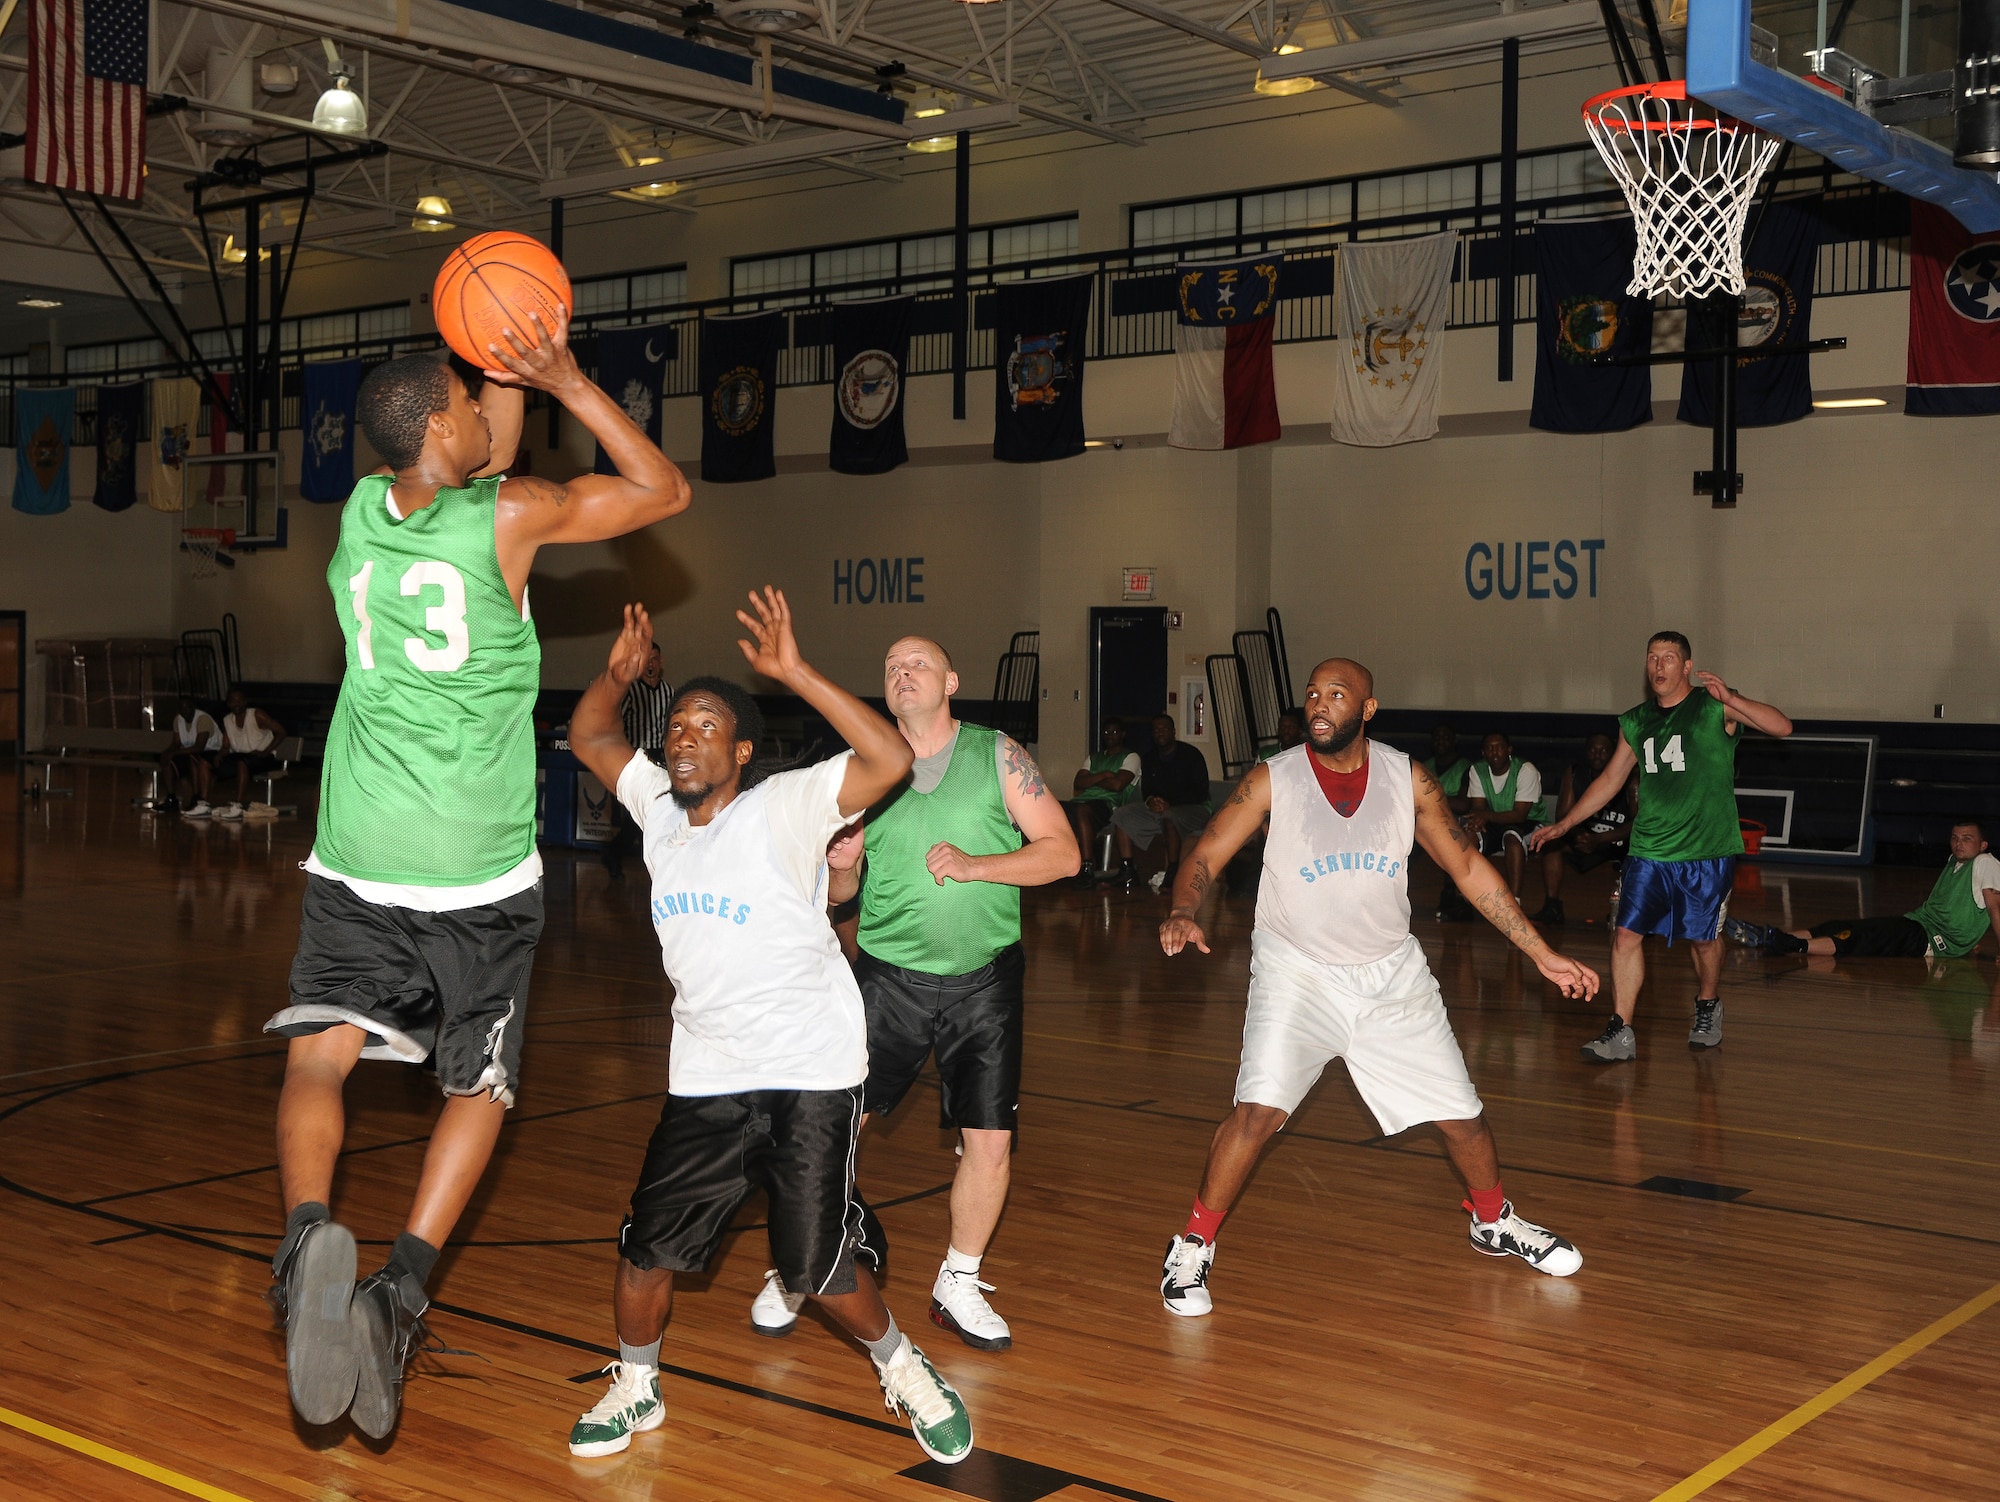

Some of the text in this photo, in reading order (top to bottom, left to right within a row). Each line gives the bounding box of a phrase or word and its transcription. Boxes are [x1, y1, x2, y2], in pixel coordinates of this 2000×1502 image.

[834, 557, 924, 604] HOME
[1130, 574, 1149, 591] EXIT
[1465, 539, 1605, 600] GUEST
[349, 560, 470, 672] 13
[1643, 734, 1686, 774] 14
[1299, 852, 1400, 883] SERVICES
